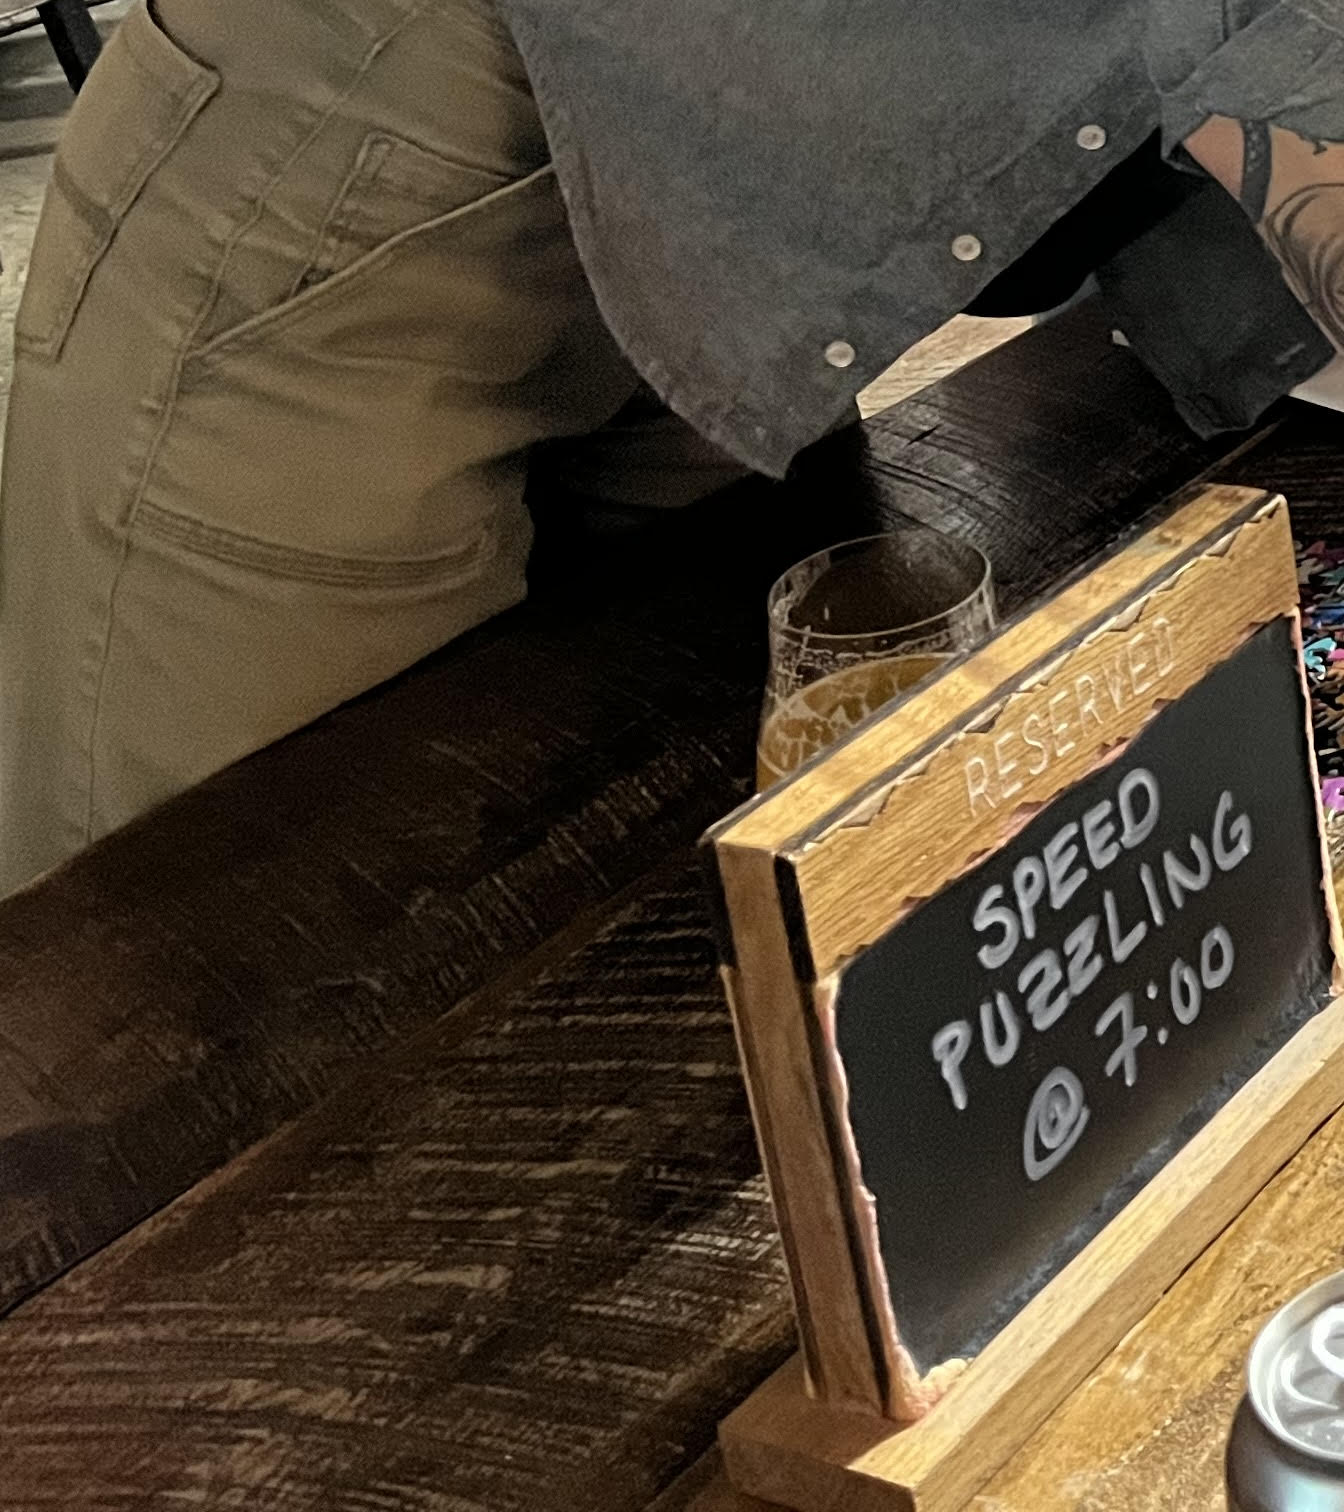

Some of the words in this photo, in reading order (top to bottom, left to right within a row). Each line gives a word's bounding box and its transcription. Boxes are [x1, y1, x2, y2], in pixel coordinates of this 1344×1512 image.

[961, 617, 1180, 816] RESERVED
[931, 789, 1254, 1111] PUZZLING
[971, 766, 1162, 970] SPEED
[1022, 1065, 1091, 1183] @
[1094, 923, 1236, 1088] 7:00
